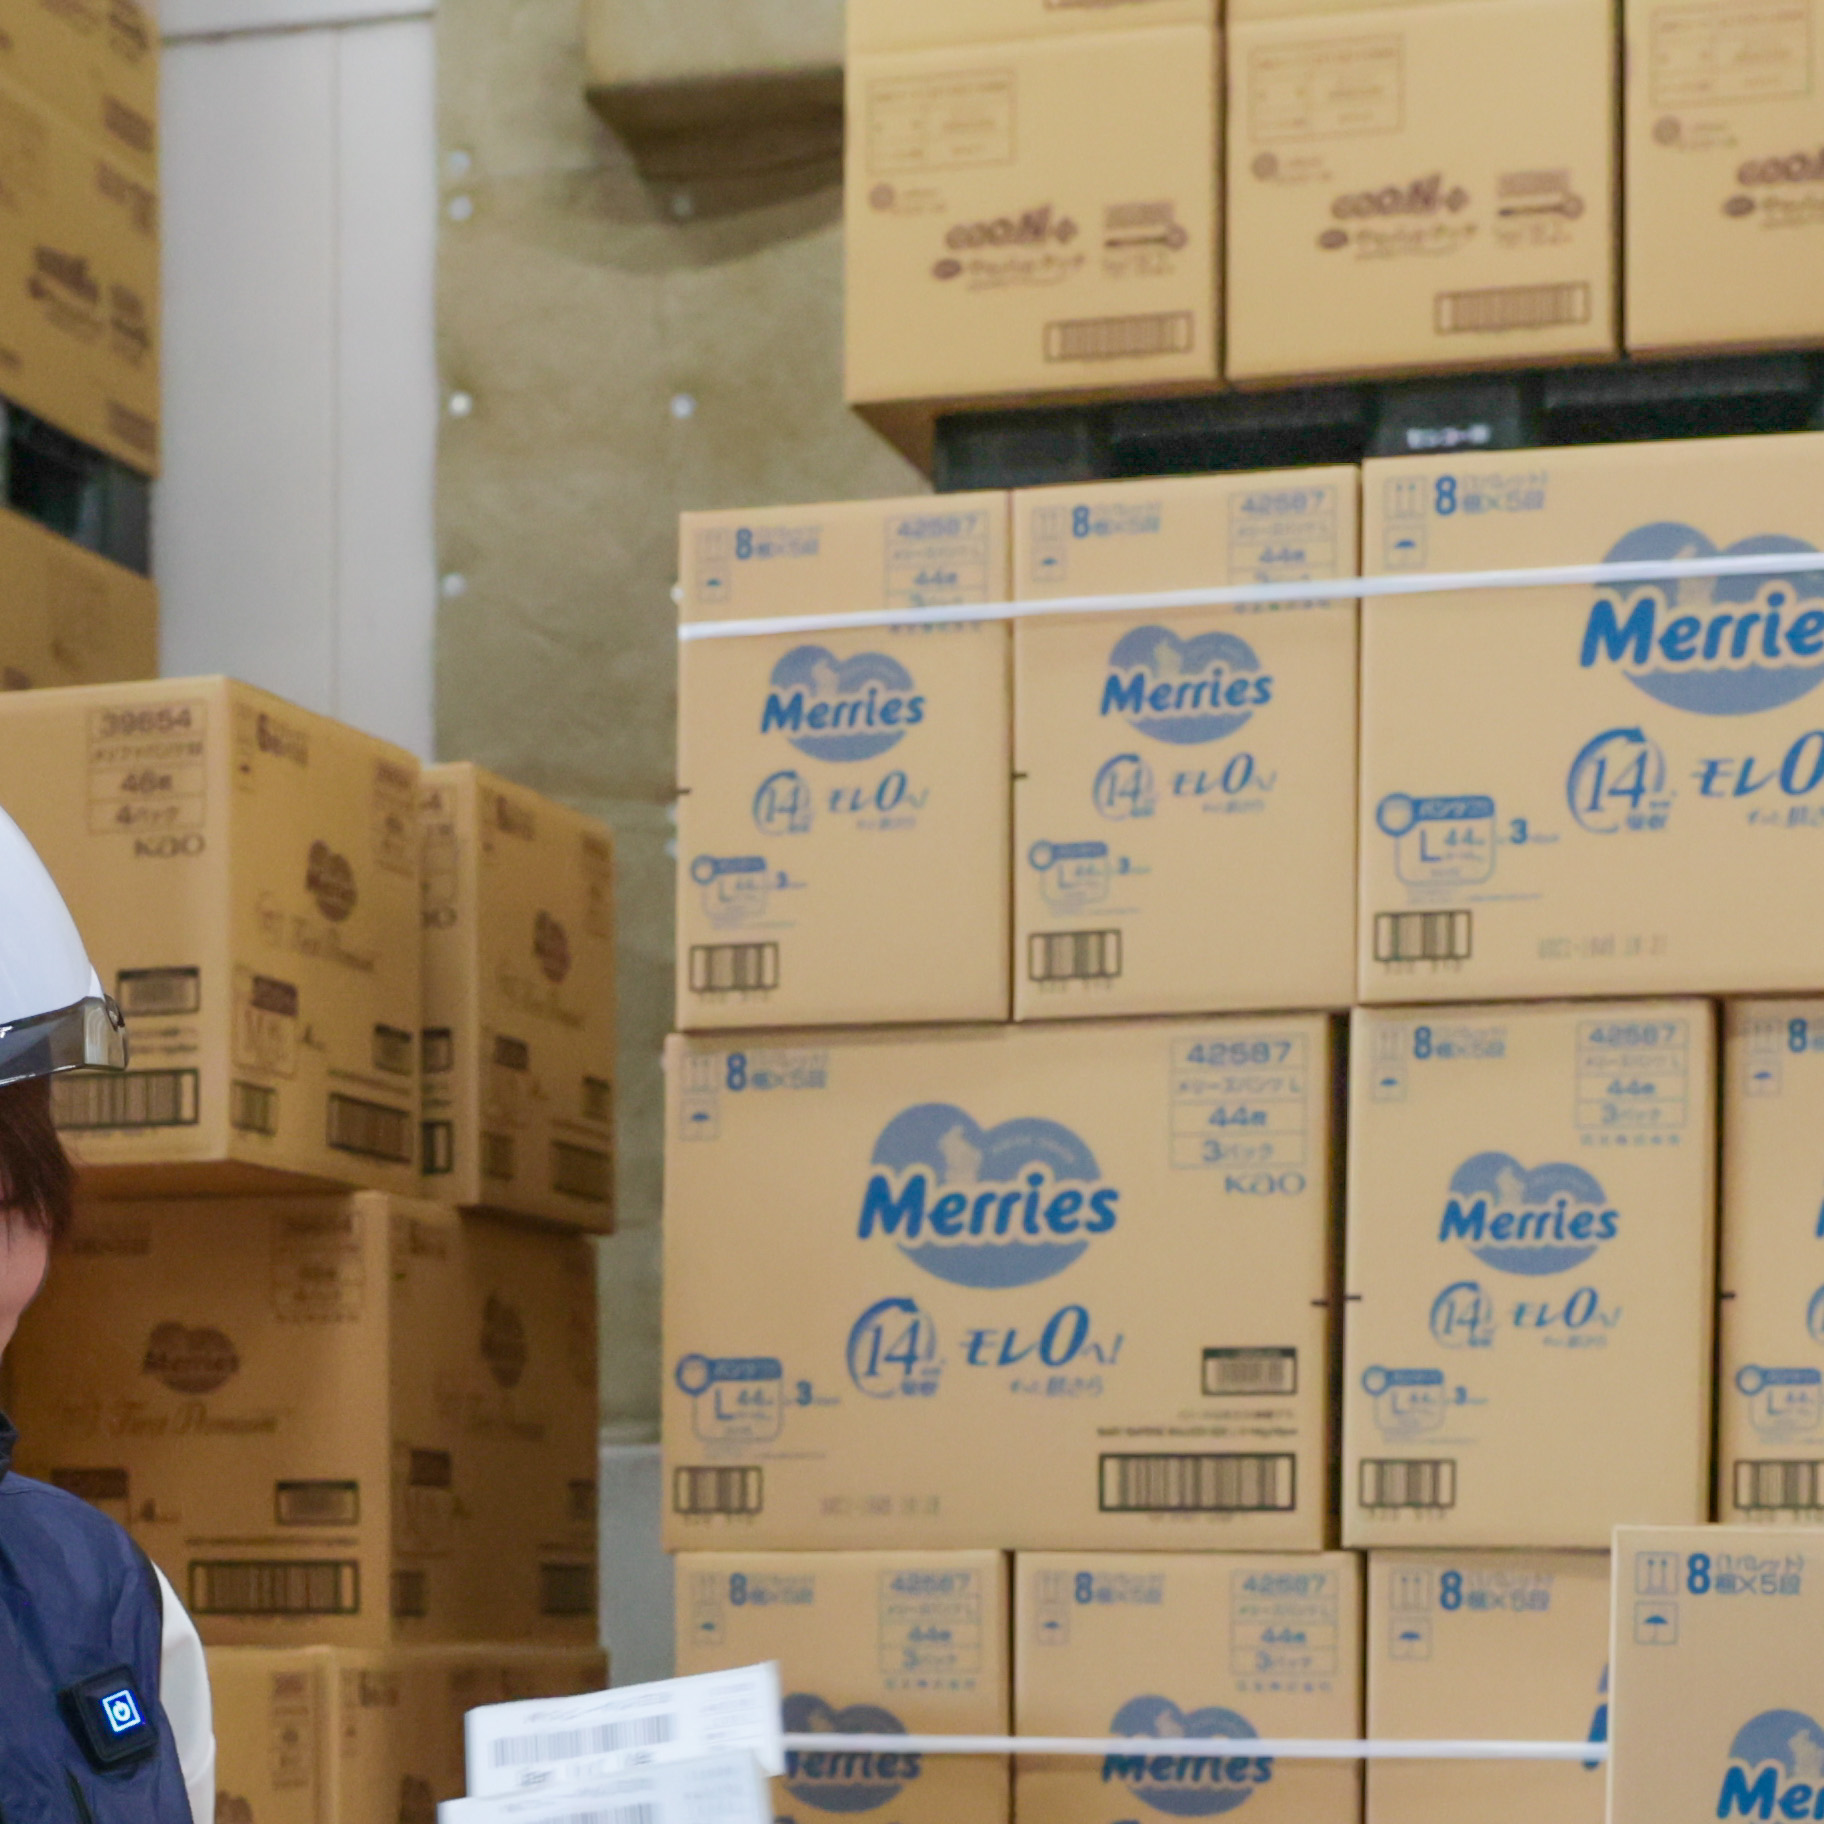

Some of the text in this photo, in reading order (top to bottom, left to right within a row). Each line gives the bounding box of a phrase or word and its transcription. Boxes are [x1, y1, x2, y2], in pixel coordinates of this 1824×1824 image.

[1435, 476, 1457, 515] 8
[761, 690, 926, 734] Merries
[1101, 669, 1273, 717] Merries
[726, 1053, 748, 1092] 8
[1185, 1041, 1292, 1065] 42587
[857, 1173, 1119, 1240] Merries
[1438, 1200, 1619, 1242] Merries
[1440, 1571, 1463, 1611] 8
[1686, 1554, 1711, 1594] 8
